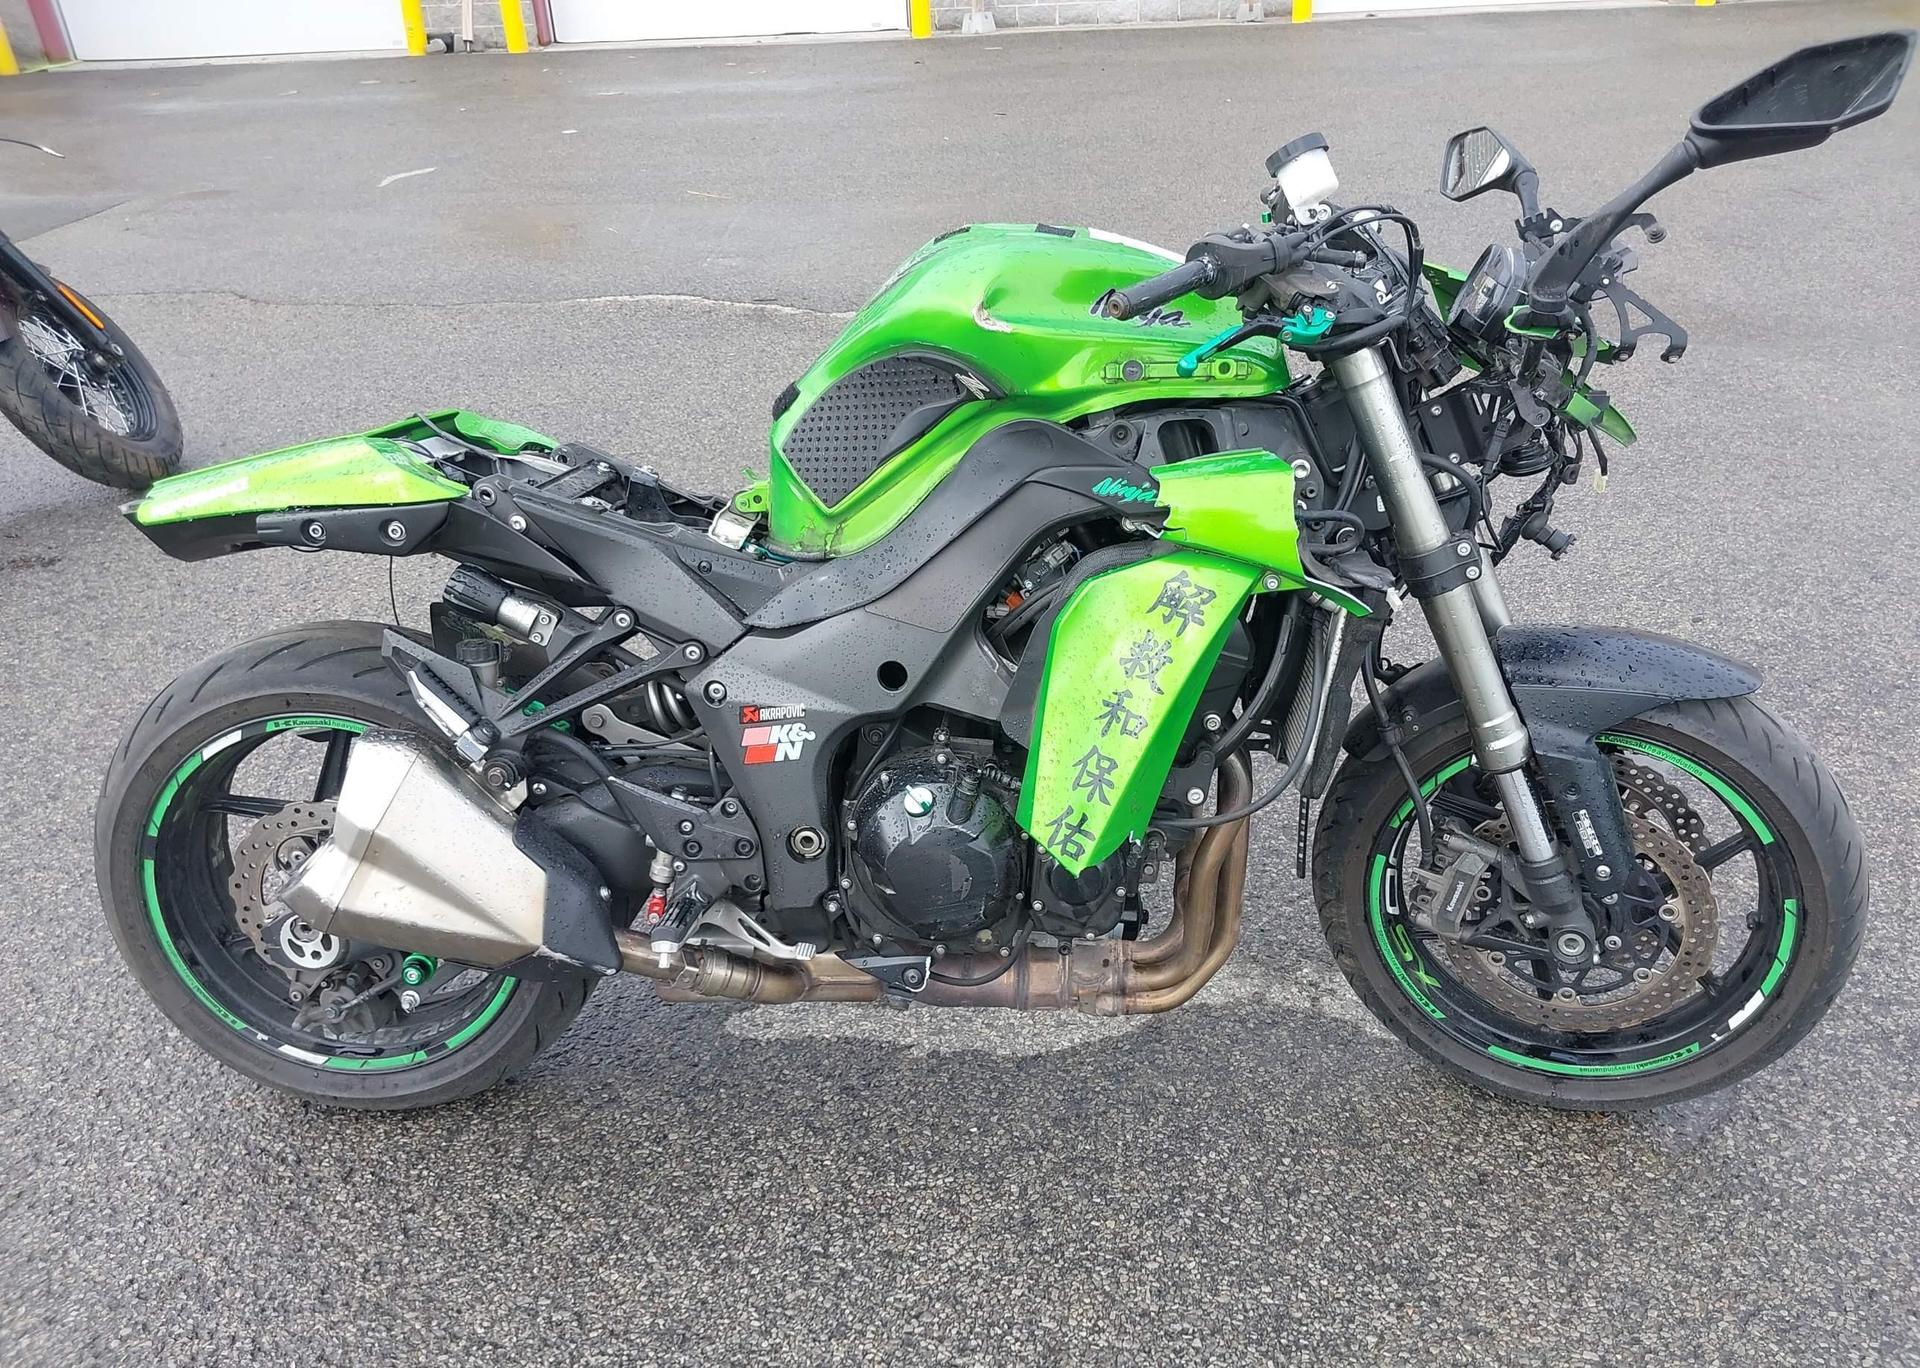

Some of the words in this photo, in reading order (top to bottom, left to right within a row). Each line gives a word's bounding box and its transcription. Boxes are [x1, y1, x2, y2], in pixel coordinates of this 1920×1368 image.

[1092, 477, 1158, 504] Ninja
[292, 719, 331, 728] Kawasaki
[1046, 569, 1217, 862] 解救和保佑
[1603, 735, 1647, 750] Kawasaki
[1446, 881, 1465, 912] Kawasaki
[1399, 974, 1425, 1003] Kawasaki
[1635, 1053, 1676, 1071] Kawasaki
